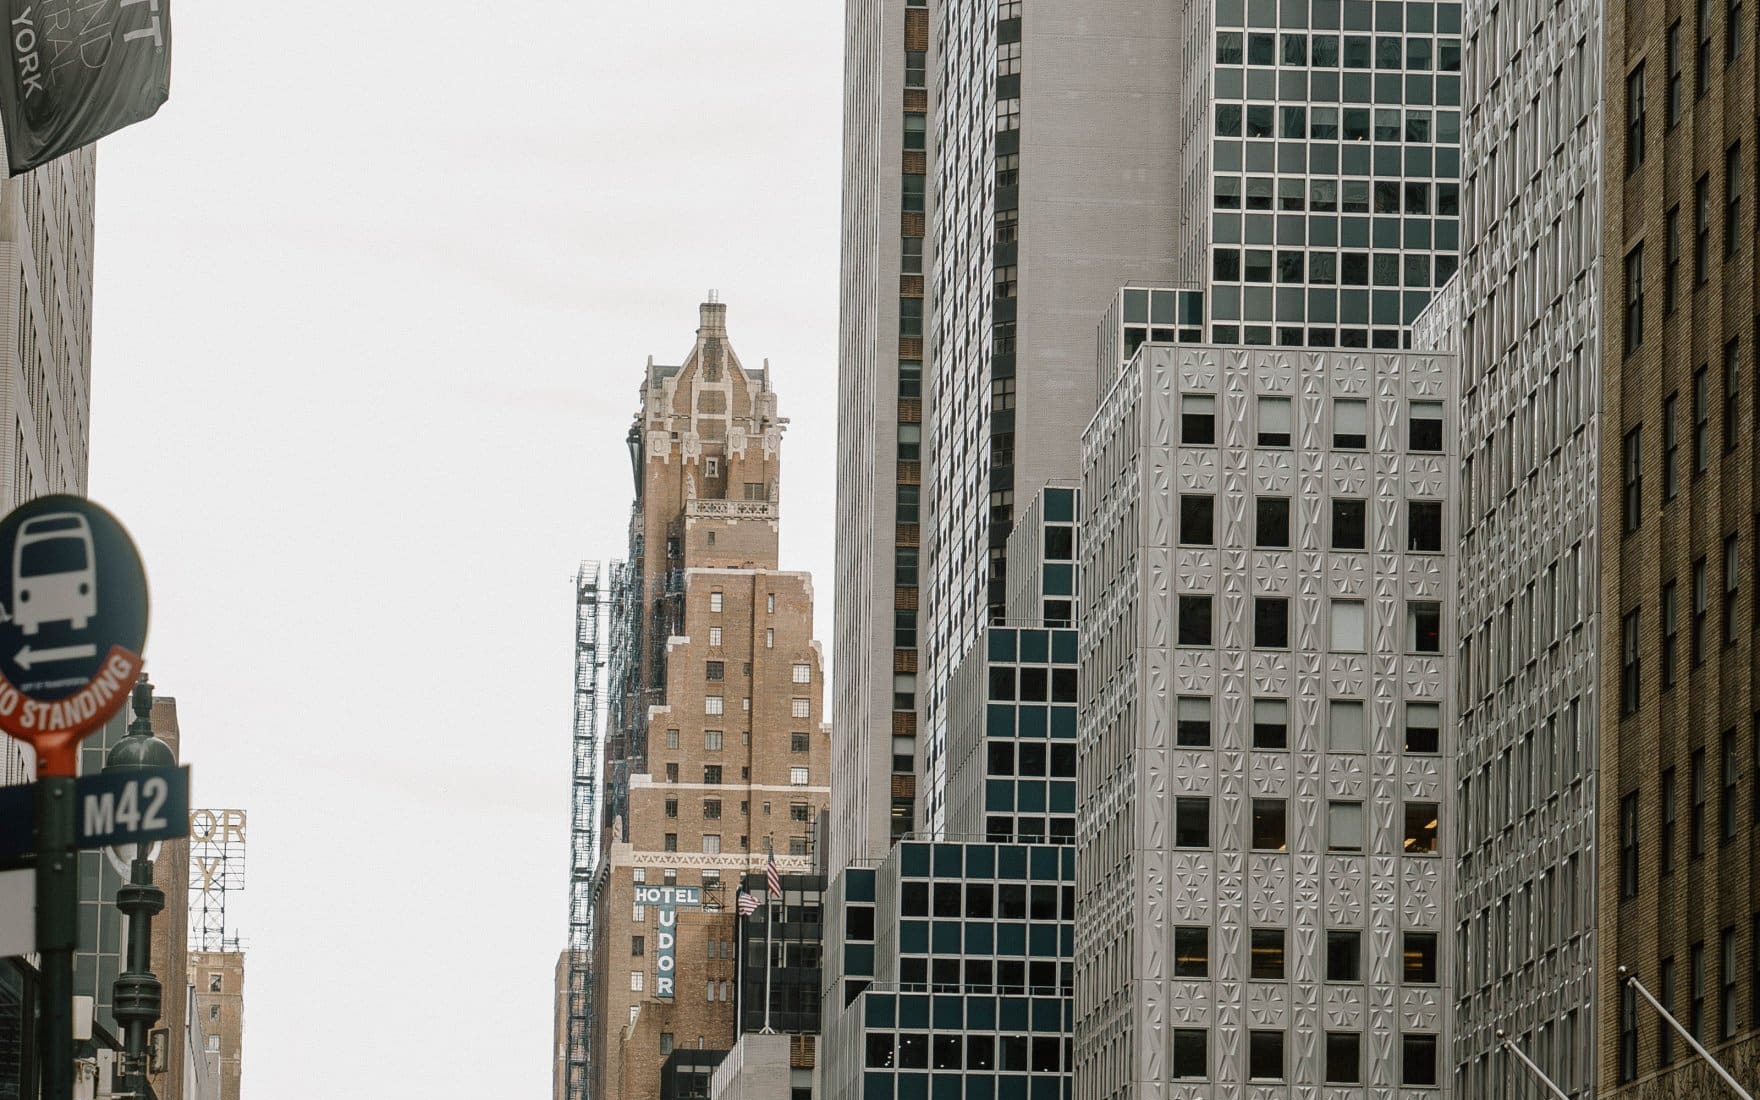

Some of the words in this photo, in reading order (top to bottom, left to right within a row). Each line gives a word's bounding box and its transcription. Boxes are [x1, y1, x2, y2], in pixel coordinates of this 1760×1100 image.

[11, 5, 43, 100] YORK
[42, 0, 76, 87] RAL
[75, 0, 114, 69] ND
[20, 655, 133, 731] STANDING
[83, 776, 169, 838] M42
[635, 887, 699, 904] HOTEL
